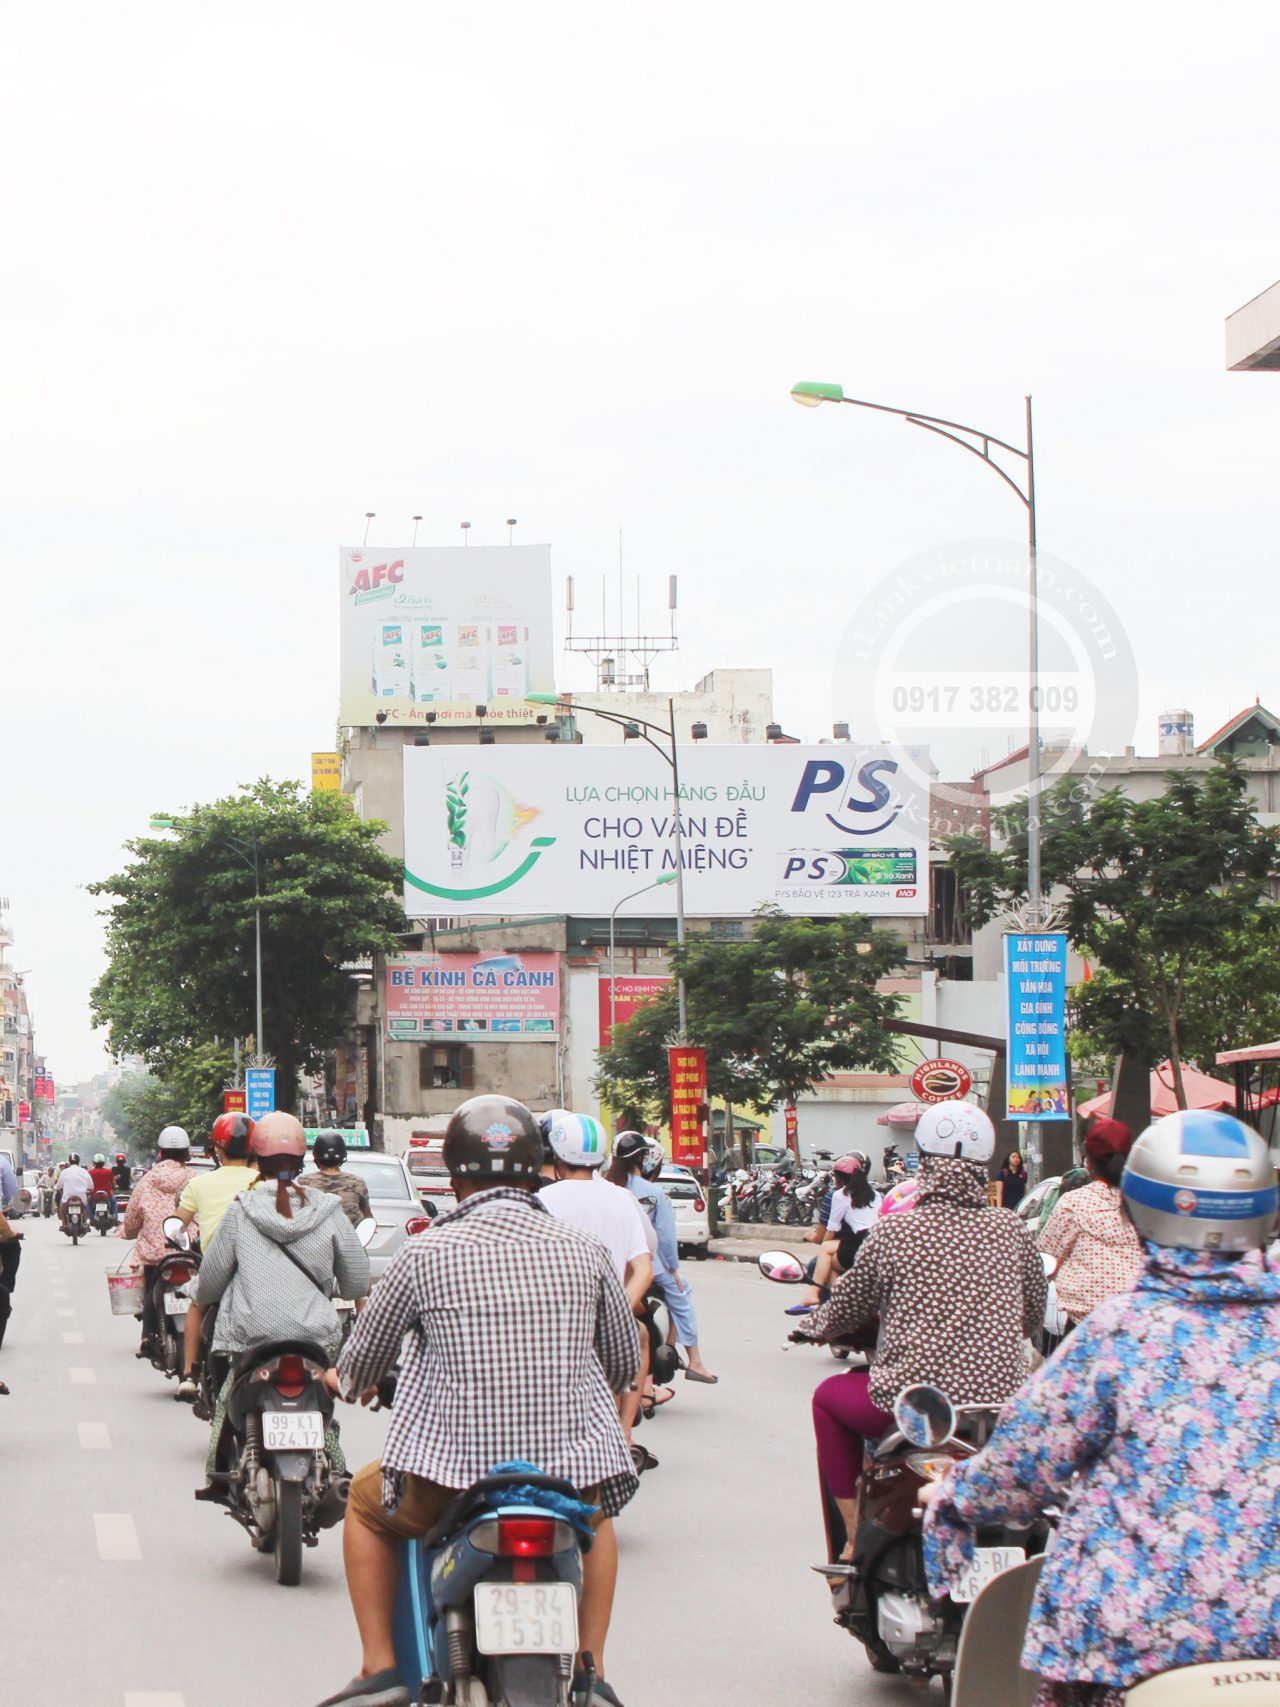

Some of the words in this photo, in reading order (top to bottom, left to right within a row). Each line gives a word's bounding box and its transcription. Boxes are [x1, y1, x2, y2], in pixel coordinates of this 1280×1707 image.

[350, 559, 404, 595] AFC
[426, 708, 452, 719] hơi
[476, 707, 503, 719] hỏe
[507, 709, 534, 721] thiệt
[566, 786, 600, 804] LỰA
[605, 786, 659, 804] CHỌN
[664, 783, 717, 801] HÀNG
[726, 780, 766, 801] ĐẦU
[584, 817, 643, 838] CHO
[651, 808, 706, 838] VẤN
[715, 807, 748, 838] ĐỀ
[580, 844, 654, 874] NHIỆT
[827, 890, 842, 898] 123
[863, 890, 890, 898] XANH
[1017, 940, 1032, 952] XÂY
[1012, 960, 1029, 973] MÔI
[392, 966, 415, 986] BỂ
[421, 968, 466, 986] KÍNH
[472, 968, 498, 987] CÁ
[503, 966, 554, 987] CẢNH
[1020, 981, 1036, 994] VĂN
[1021, 1002, 1033, 1014] GIA
[1015, 1022, 1037, 1037] CỘNG
[914, 1061, 969, 1080] HIGHLANDS
[922, 1091, 963, 1103] COFFEE
[272, 1415, 313, 1429] 99-K1
[269, 1431, 319, 1447] 024.17
[490, 1588, 562, 1616] 29-R4
[493, 1619, 563, 1647] 1538
[1211, 1671, 1280, 1688] HON
